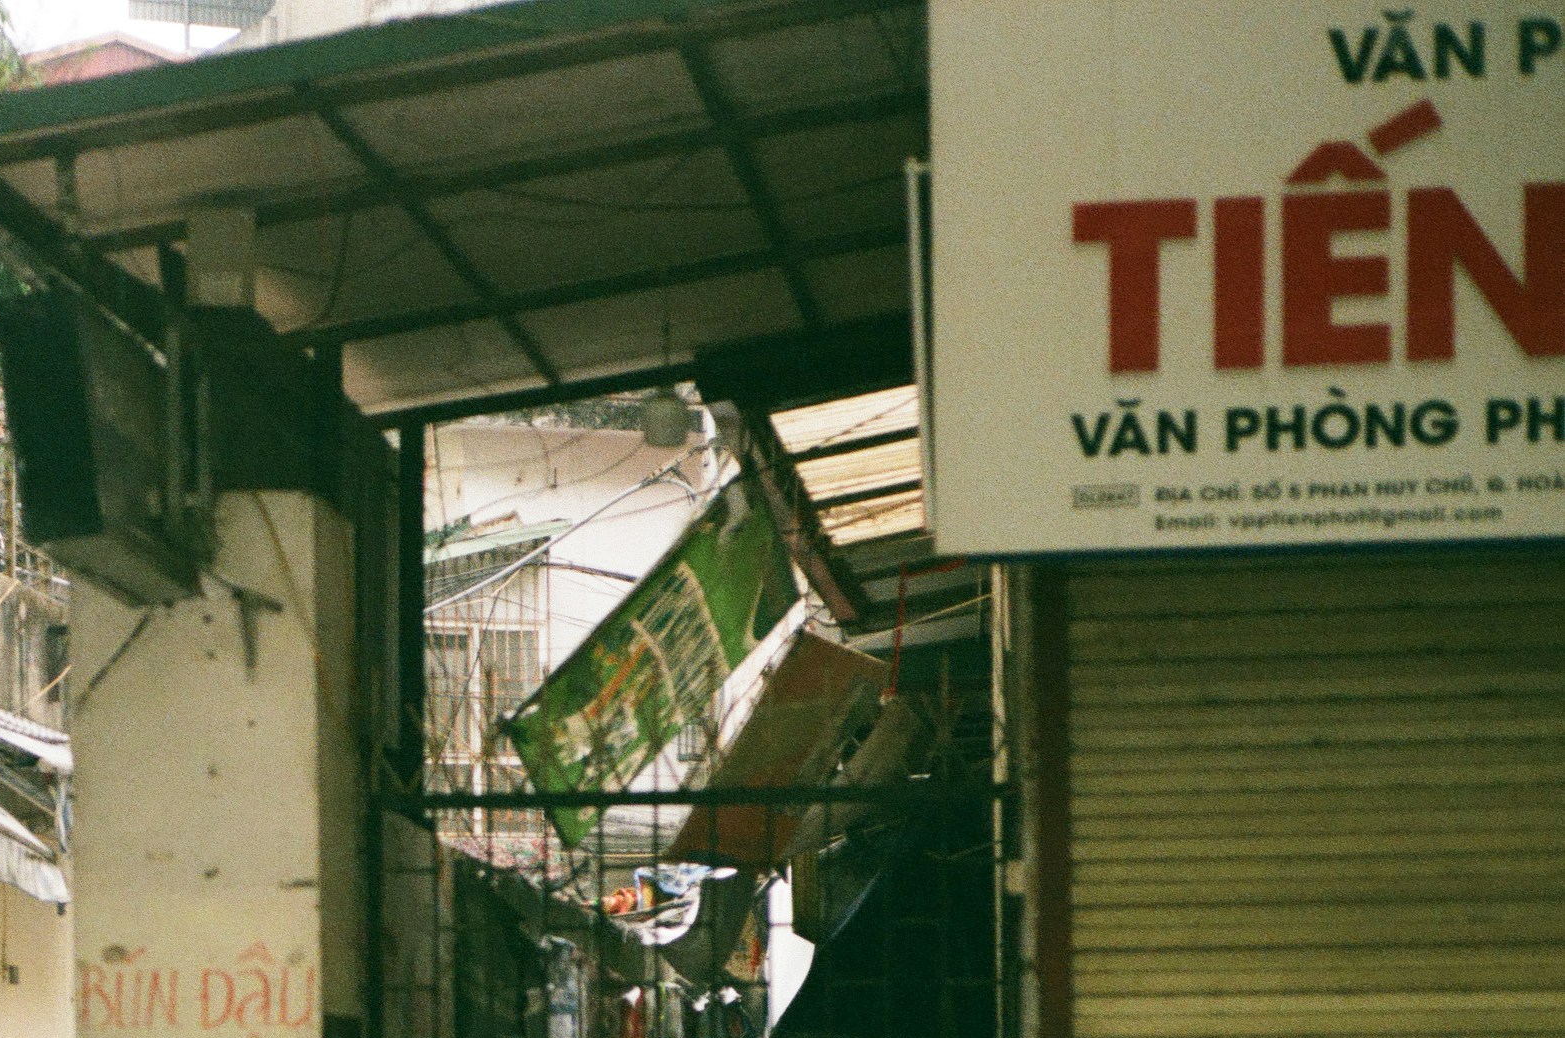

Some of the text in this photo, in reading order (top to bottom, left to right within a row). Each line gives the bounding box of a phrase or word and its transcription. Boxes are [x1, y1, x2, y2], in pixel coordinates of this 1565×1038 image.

[1328, 9, 1485, 84] VĂN
[1073, 98, 1565, 376] TIẾN
[1072, 399, 1197, 458] VĂN
[1225, 386, 1460, 454] PHÒNG
[1307, 480, 1369, 498] PHAN
